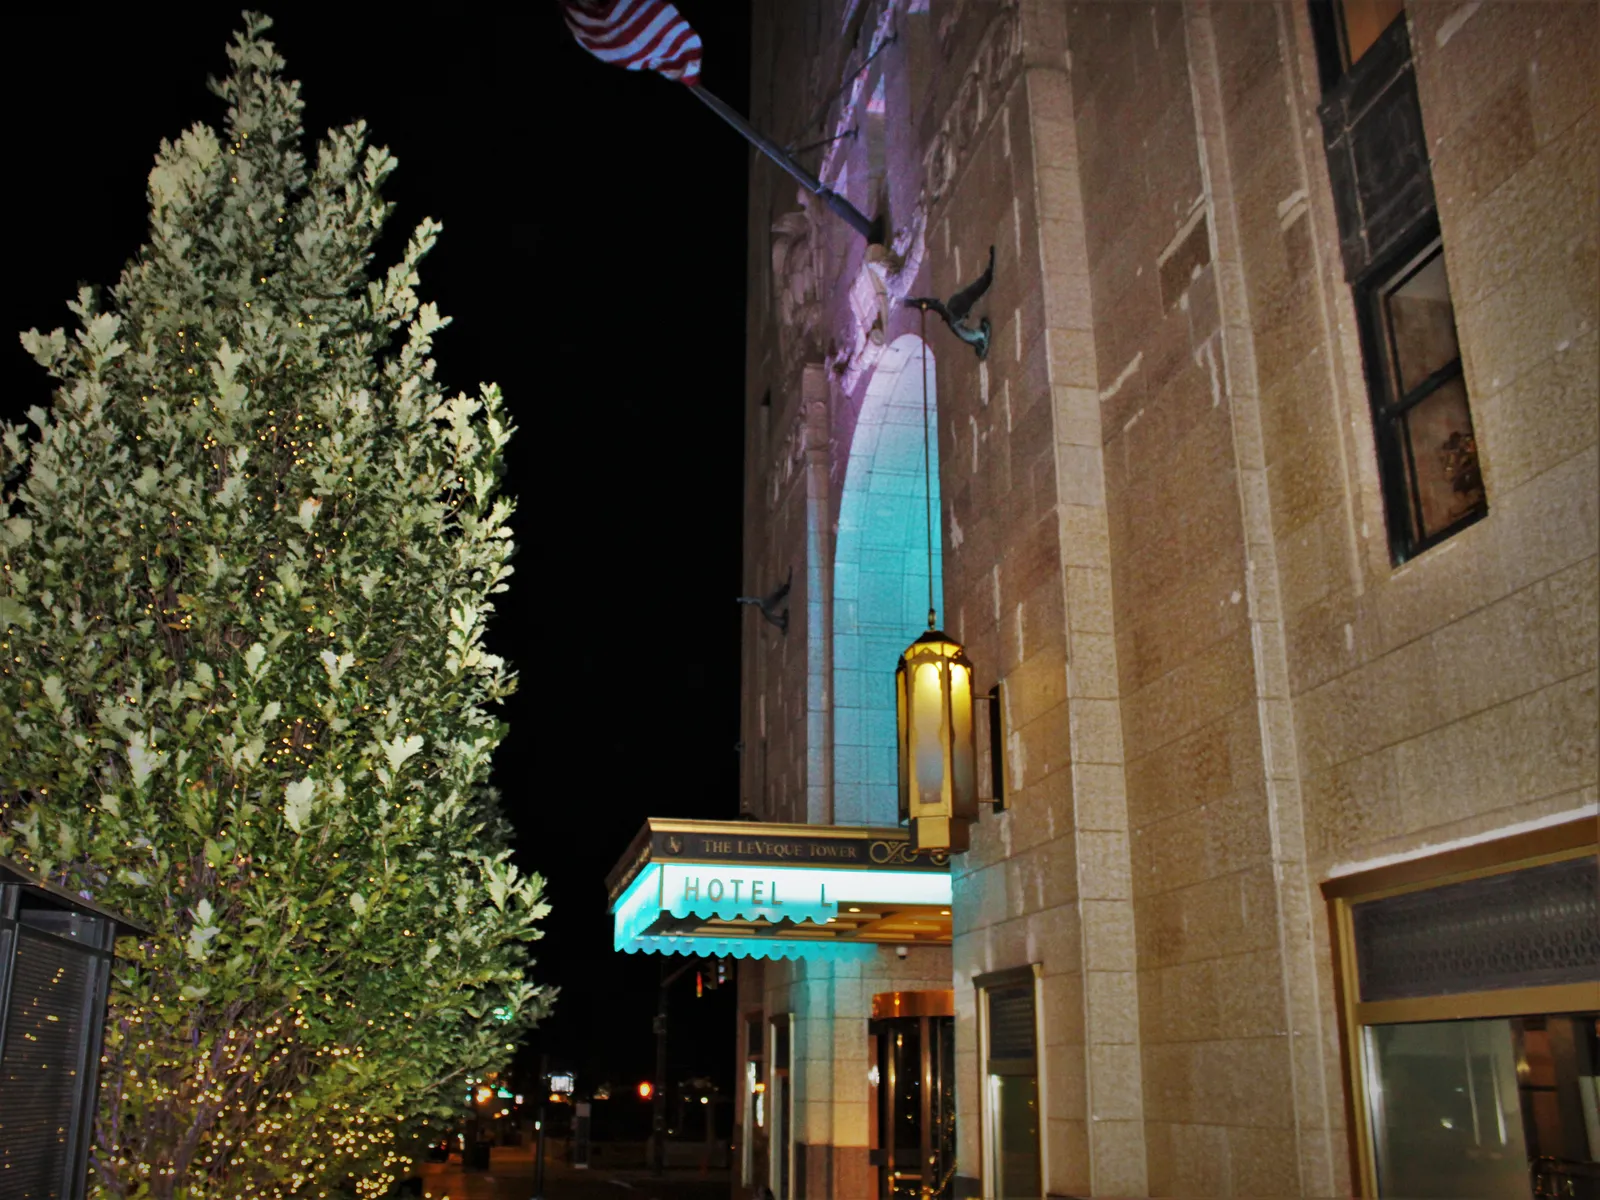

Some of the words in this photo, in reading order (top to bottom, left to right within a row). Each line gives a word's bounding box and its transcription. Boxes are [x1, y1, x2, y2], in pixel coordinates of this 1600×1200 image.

[703, 839, 732, 854] THE
[810, 843, 857, 858] TOWER
[685, 876, 783, 905] HOTEL
[821, 883, 832, 907] L
